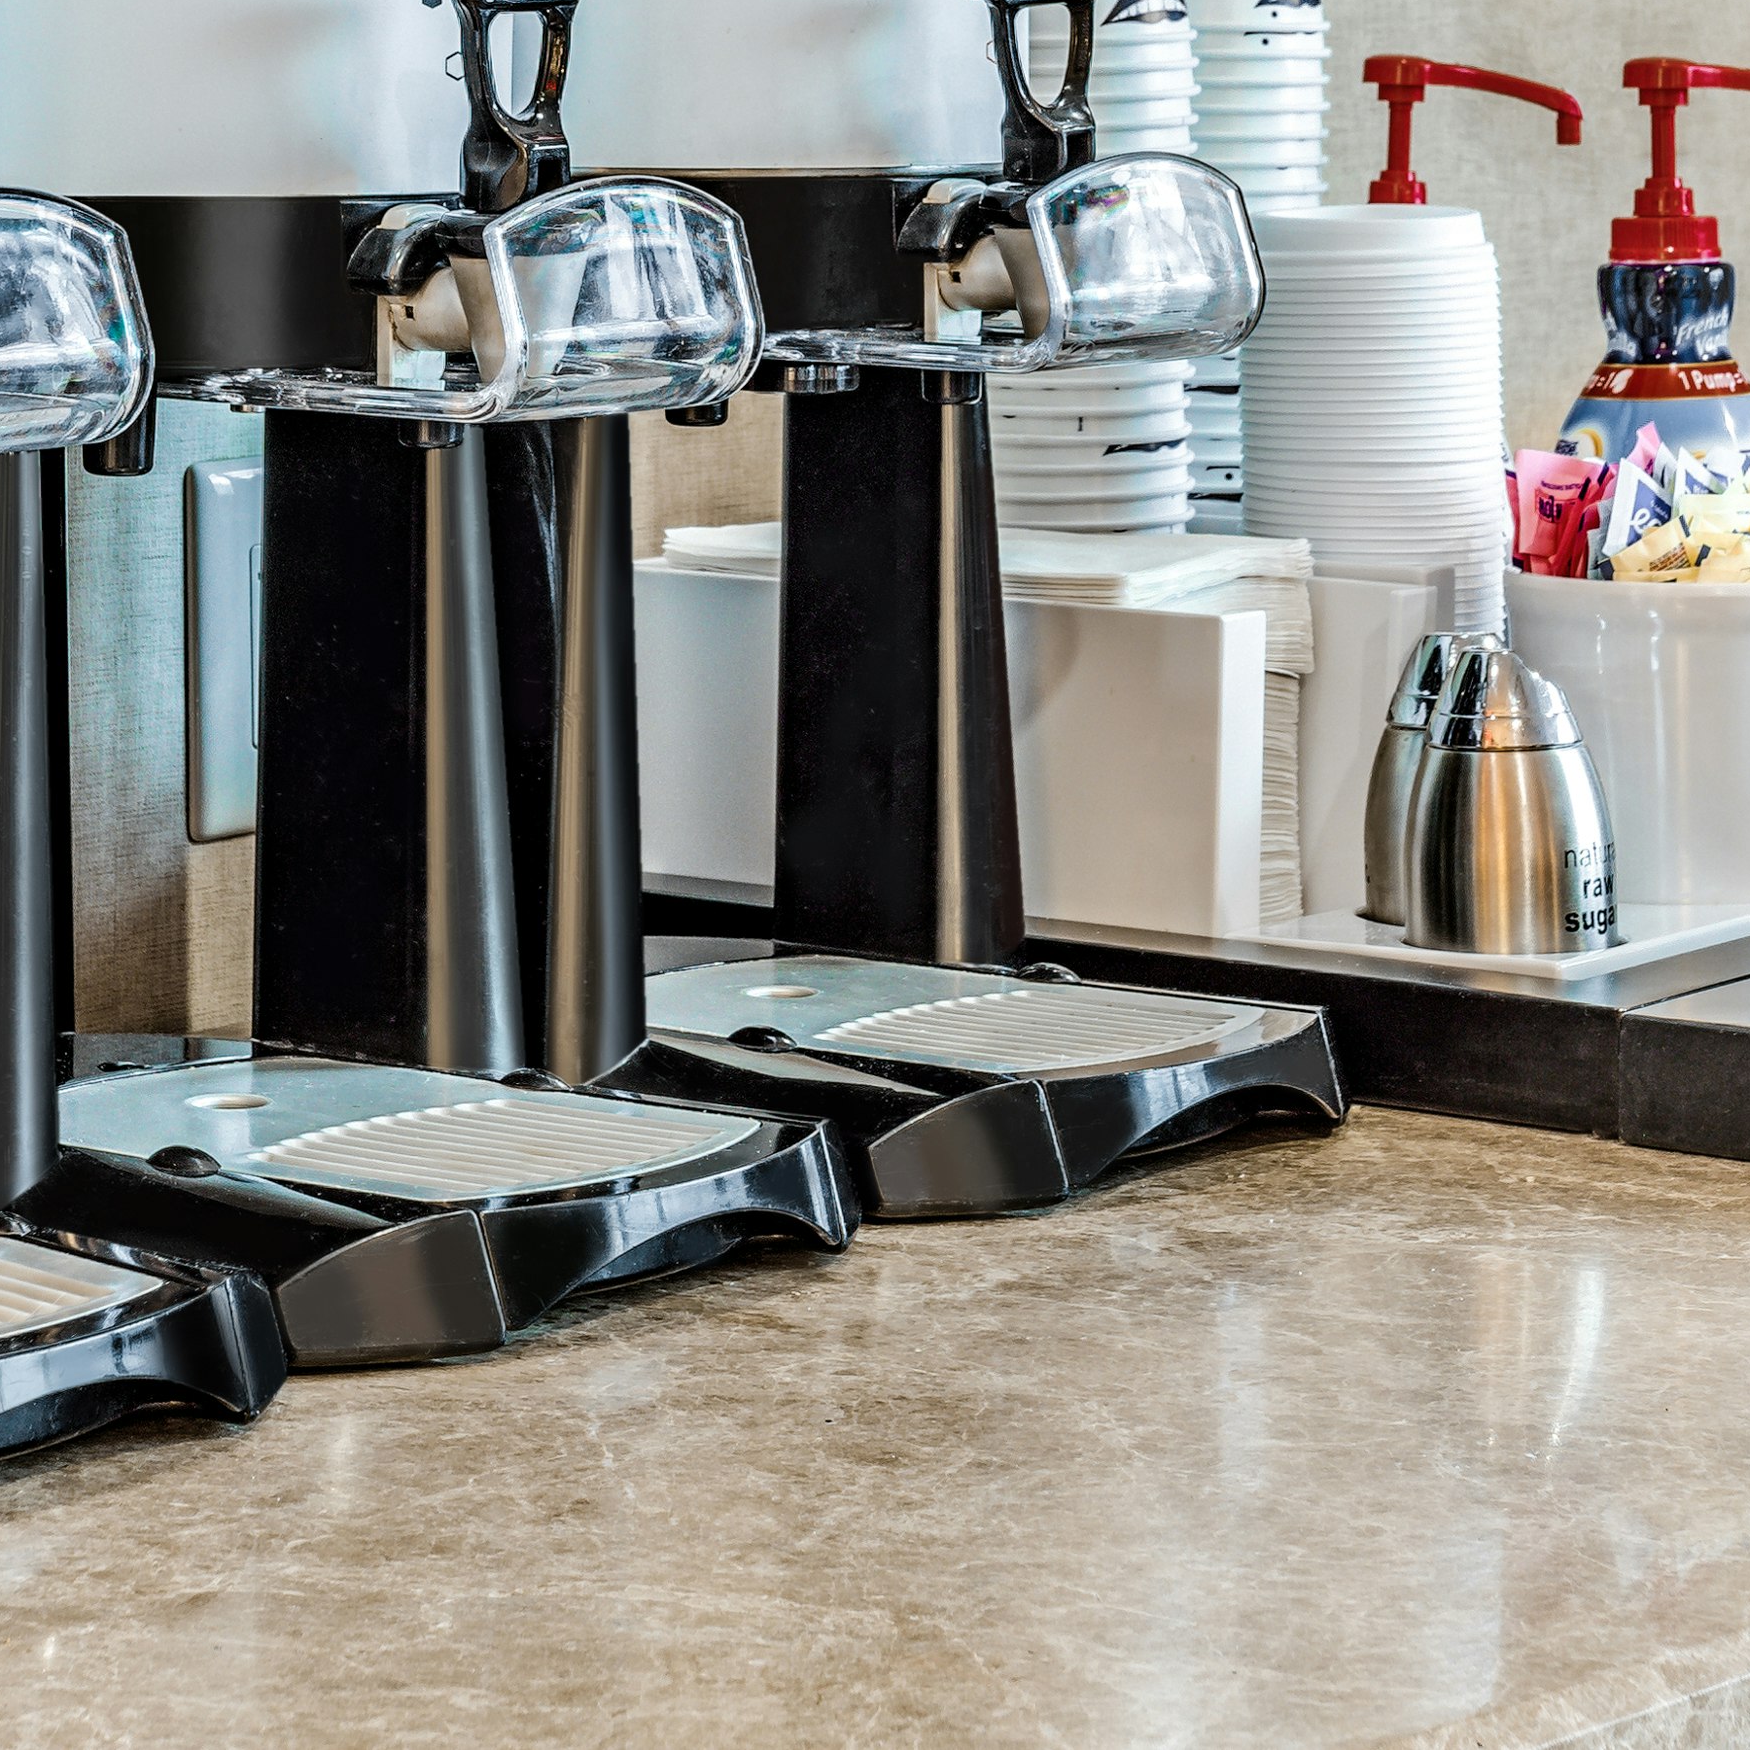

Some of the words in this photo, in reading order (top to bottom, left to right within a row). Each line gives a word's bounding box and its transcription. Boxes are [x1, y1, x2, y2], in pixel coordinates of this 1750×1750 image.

[1676, 304, 1729, 346] French
[1583, 874, 1614, 898] raw
[1564, 904, 1616, 934] suga
